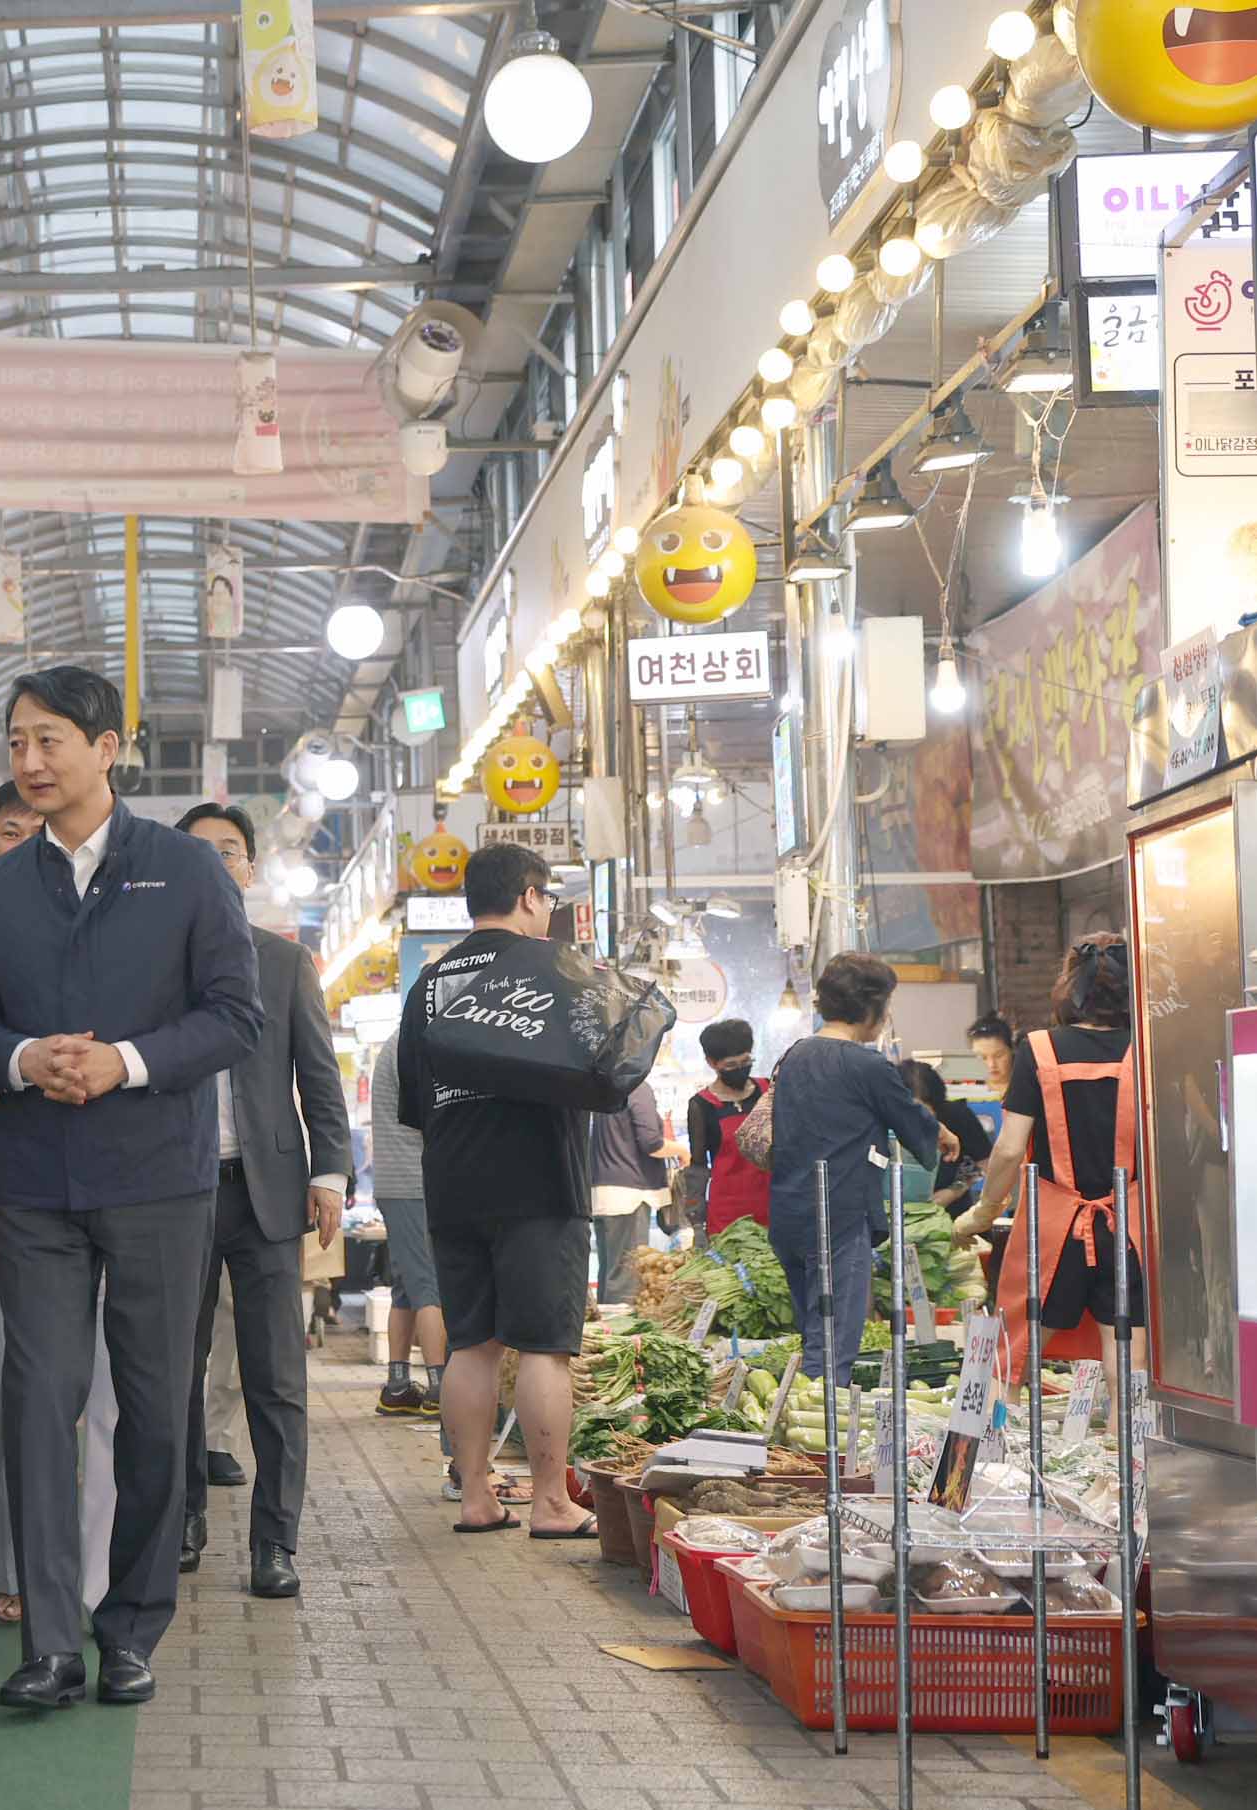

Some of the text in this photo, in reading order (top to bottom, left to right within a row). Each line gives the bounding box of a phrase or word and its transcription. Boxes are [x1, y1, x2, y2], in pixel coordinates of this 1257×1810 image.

[638, 648, 761, 685] 여천상회
[438, 951, 496, 973] DIRECTION
[425, 978, 437, 1024] YORK
